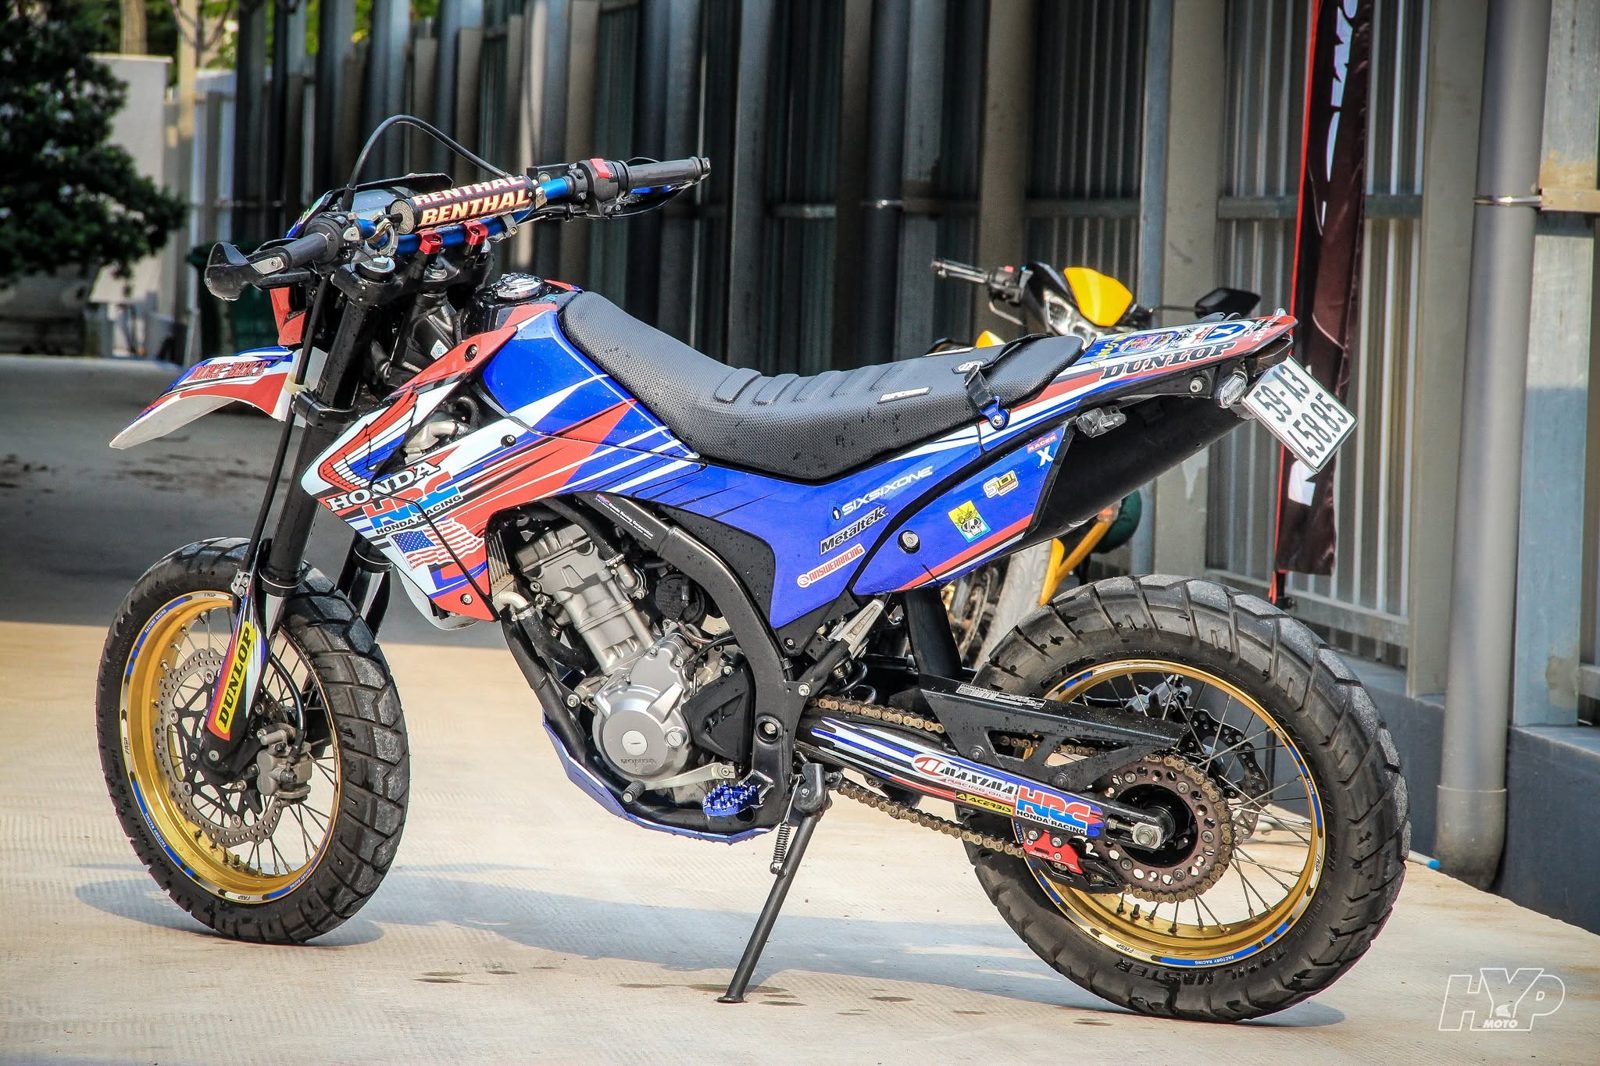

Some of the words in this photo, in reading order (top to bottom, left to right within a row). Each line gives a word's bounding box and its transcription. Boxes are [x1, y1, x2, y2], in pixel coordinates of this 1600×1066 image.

[411, 176, 526, 206] RENTHAL
[420, 188, 531, 226] RENTHAL
[1101, 341, 1236, 380] DUNLOP
[1253, 363, 1310, 423] 59-A3
[1287, 392, 1349, 459] 458.85
[326, 461, 441, 512] HONDA
[361, 470, 460, 530] HRC
[841, 465, 934, 516] SIXSIXONE
[376, 518, 417, 535] HONDA
[416, 494, 463, 525] RACING
[820, 507, 887, 554] Metaltek
[219, 626, 252, 728] DUNLOP
[1016, 784, 1091, 831] HRC
[1017, 810, 1049, 824] HONDA
[1050, 820, 1085, 836] RACING
[1213, 955, 1235, 963] FACTORY
